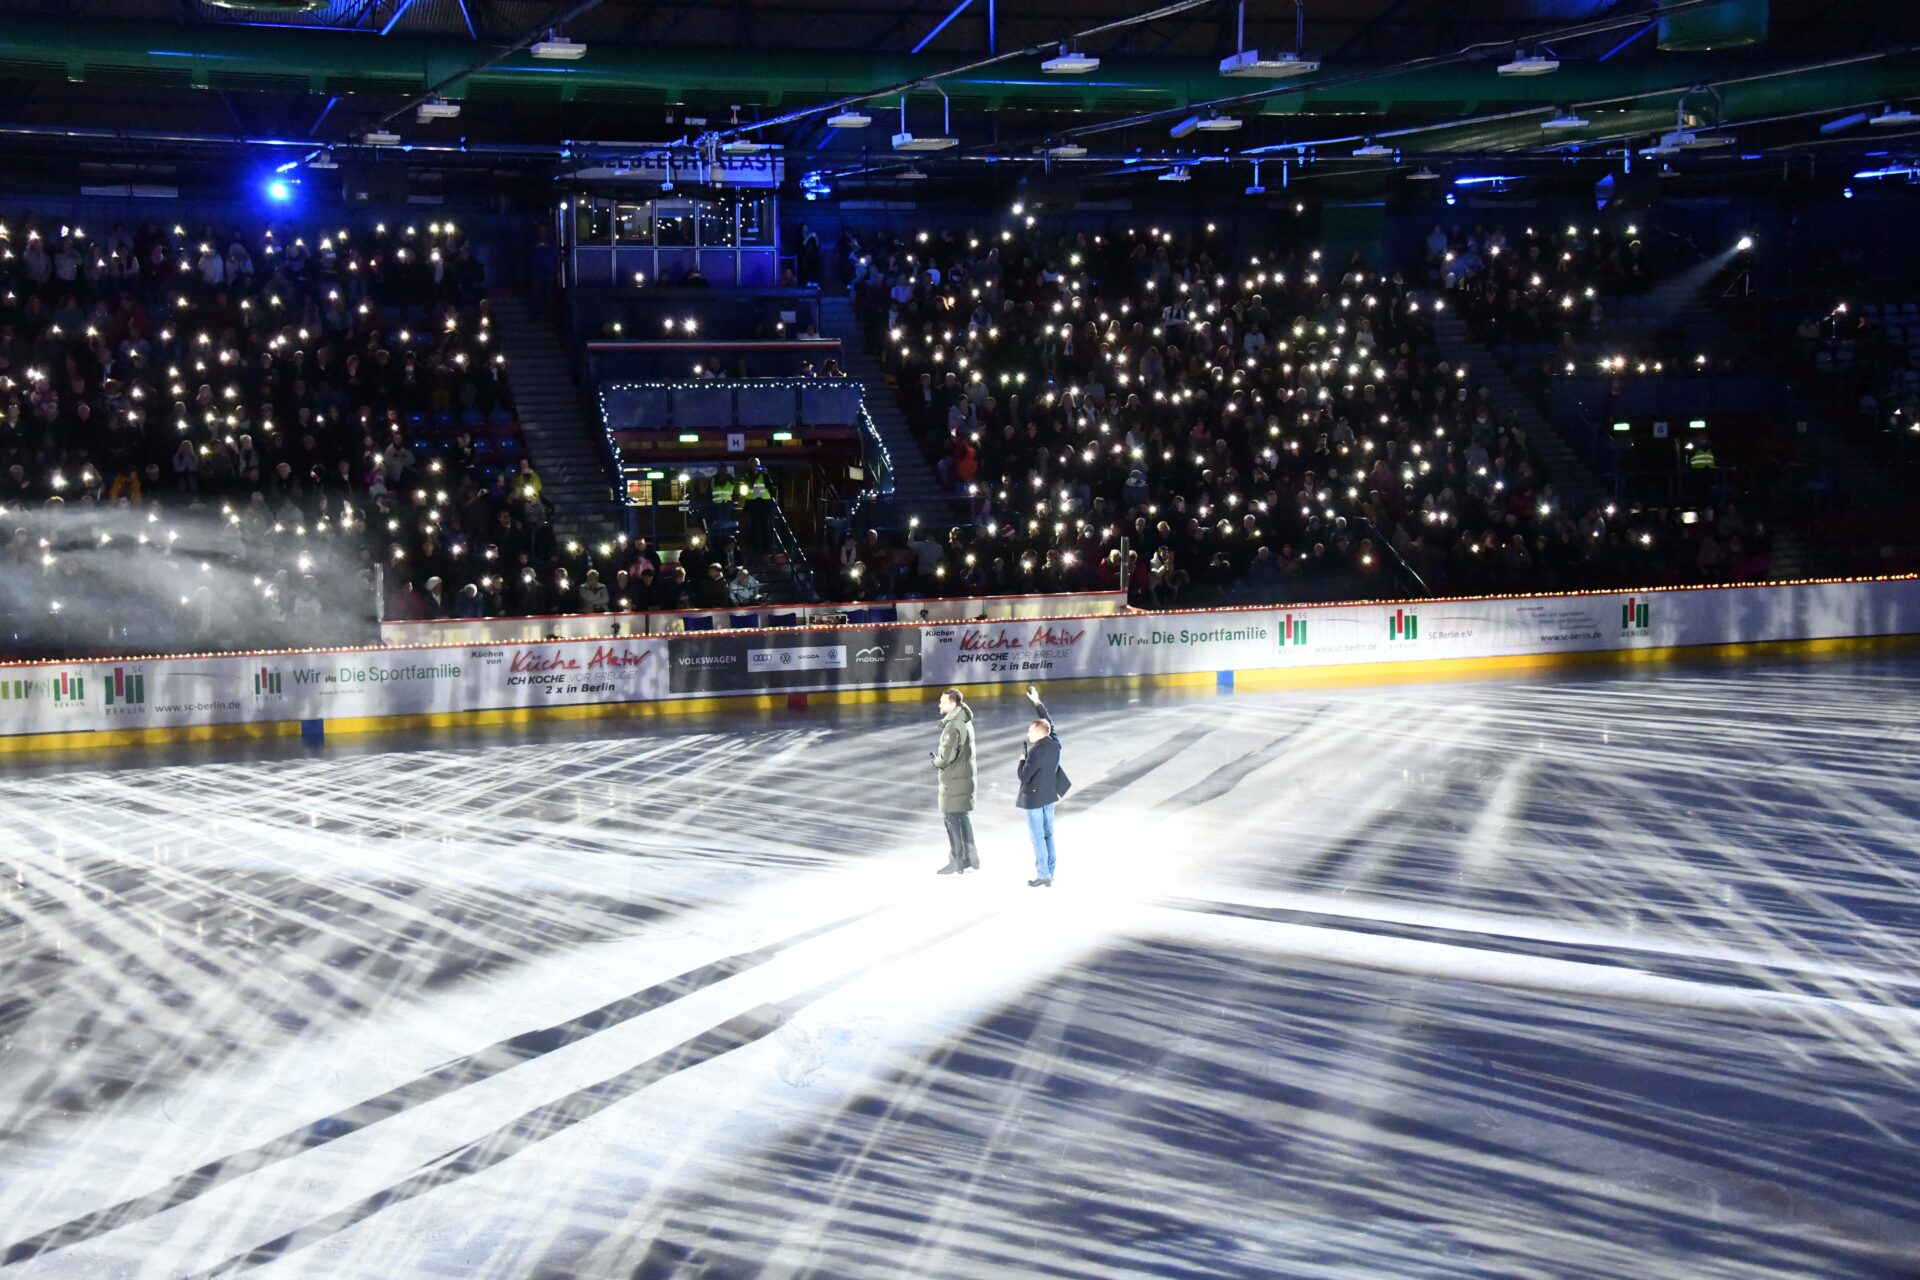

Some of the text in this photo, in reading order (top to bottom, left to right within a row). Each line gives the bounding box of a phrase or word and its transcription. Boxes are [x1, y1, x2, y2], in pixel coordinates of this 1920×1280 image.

[732, 439, 740, 448] H
[925, 629, 955, 637] Küchen
[960, 625, 1086, 651] Küche Aktiv
[1107, 627, 1267, 647] Wir Die Sportfamilie
[471, 650, 504, 658] Küchen
[510, 646, 650, 673] Küche Aktiv
[957, 654, 974, 664] ICH
[976, 652, 1009, 662] KOCHE
[679, 655, 737, 665] VOLKSWAGEN
[990, 663, 998, 672] 2
[1009, 662, 1019, 671] in
[1022, 661, 1053, 671] Berlin
[293, 664, 461, 684] Wir Die Sportfamilie
[507, 676, 526, 686] ICH
[528, 674, 565, 685] KOCHE
[545, 686, 552, 694] 2
[566, 684, 577, 693] in
[581, 683, 615, 692] Berlin
[105, 707, 145, 715] BERLIN
[155, 701, 241, 713] www.sc-berlin.de
